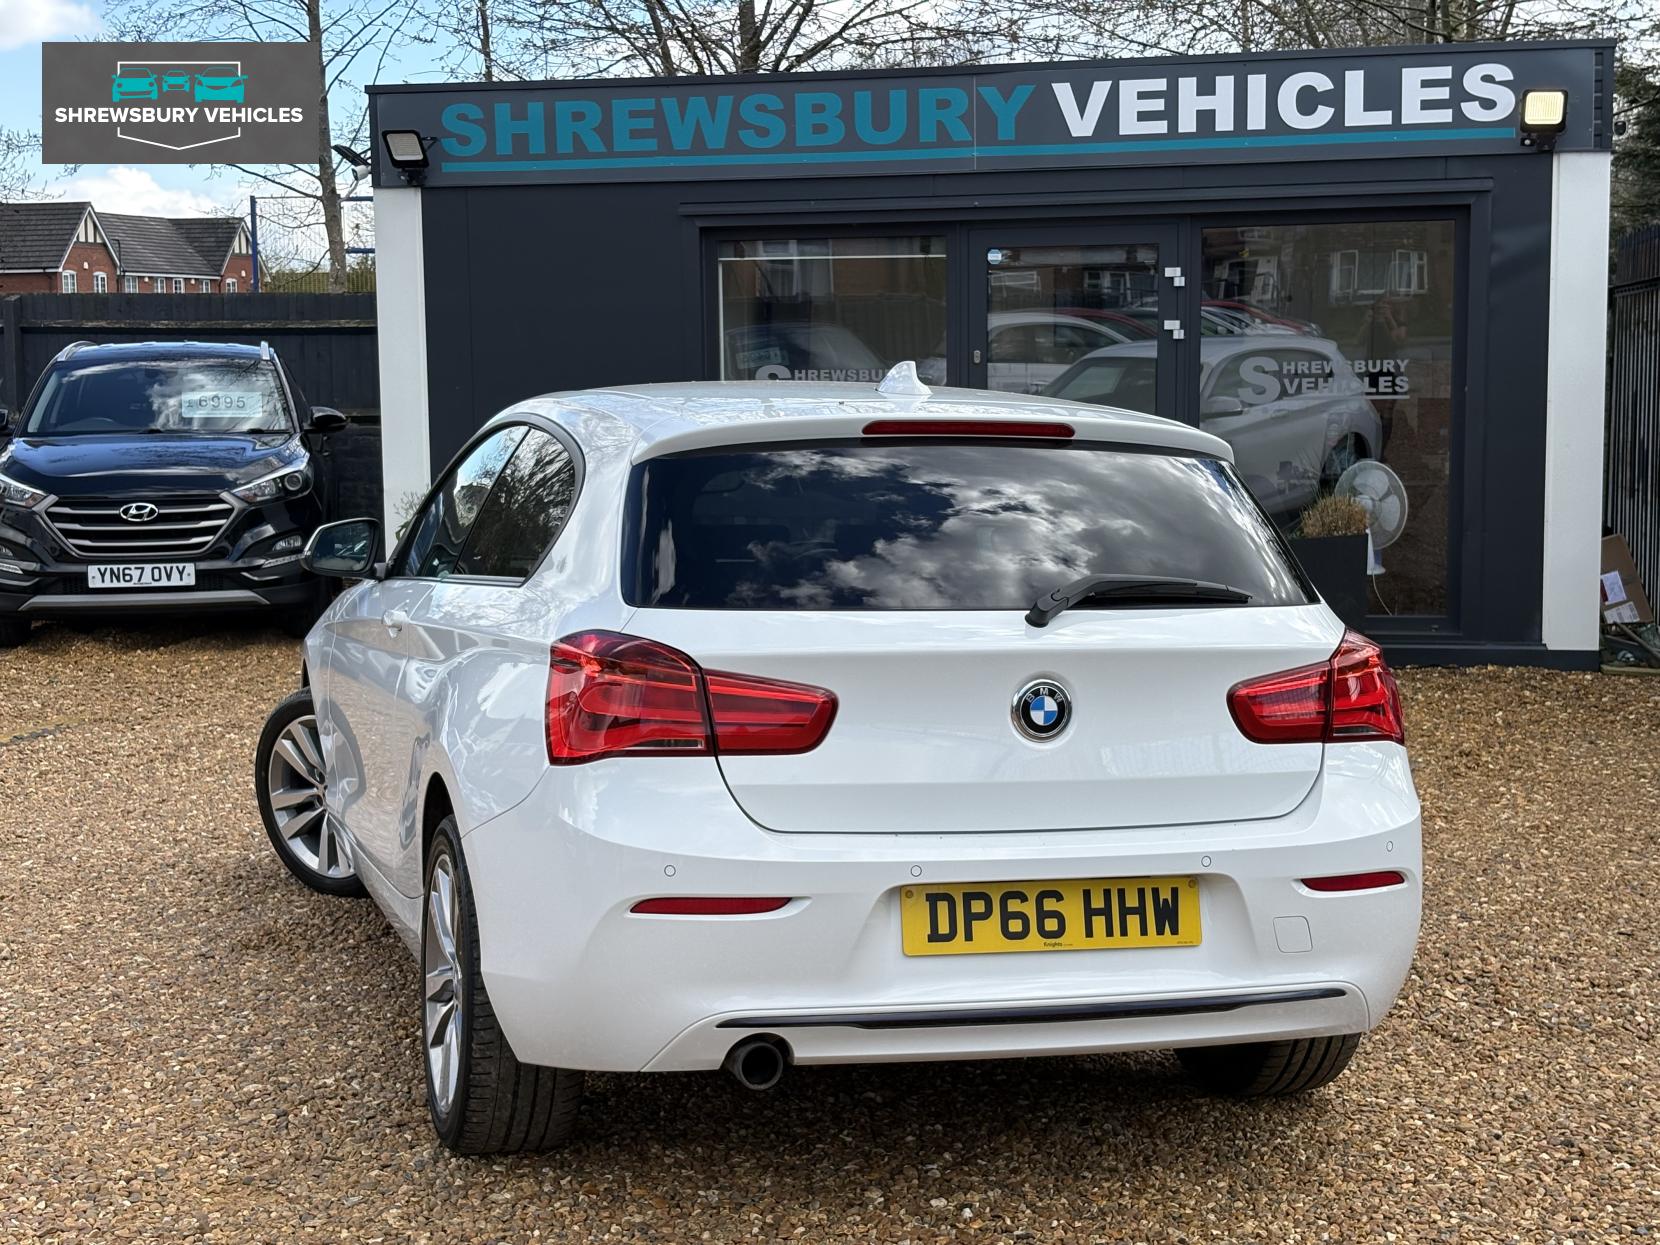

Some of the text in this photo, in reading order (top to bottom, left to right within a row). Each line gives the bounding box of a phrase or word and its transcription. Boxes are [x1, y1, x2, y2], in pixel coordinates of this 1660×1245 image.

[441, 63, 1517, 157] SHREWSBURY VEHICLES
[755, 364, 890, 381] HREWSBU
[1282, 375, 1410, 394] VEHILES
[97, 565, 187, 583] YN67 OVY
[1025, 687, 1063, 703] BMW
[925, 886, 1180, 943] DP66 HHW
